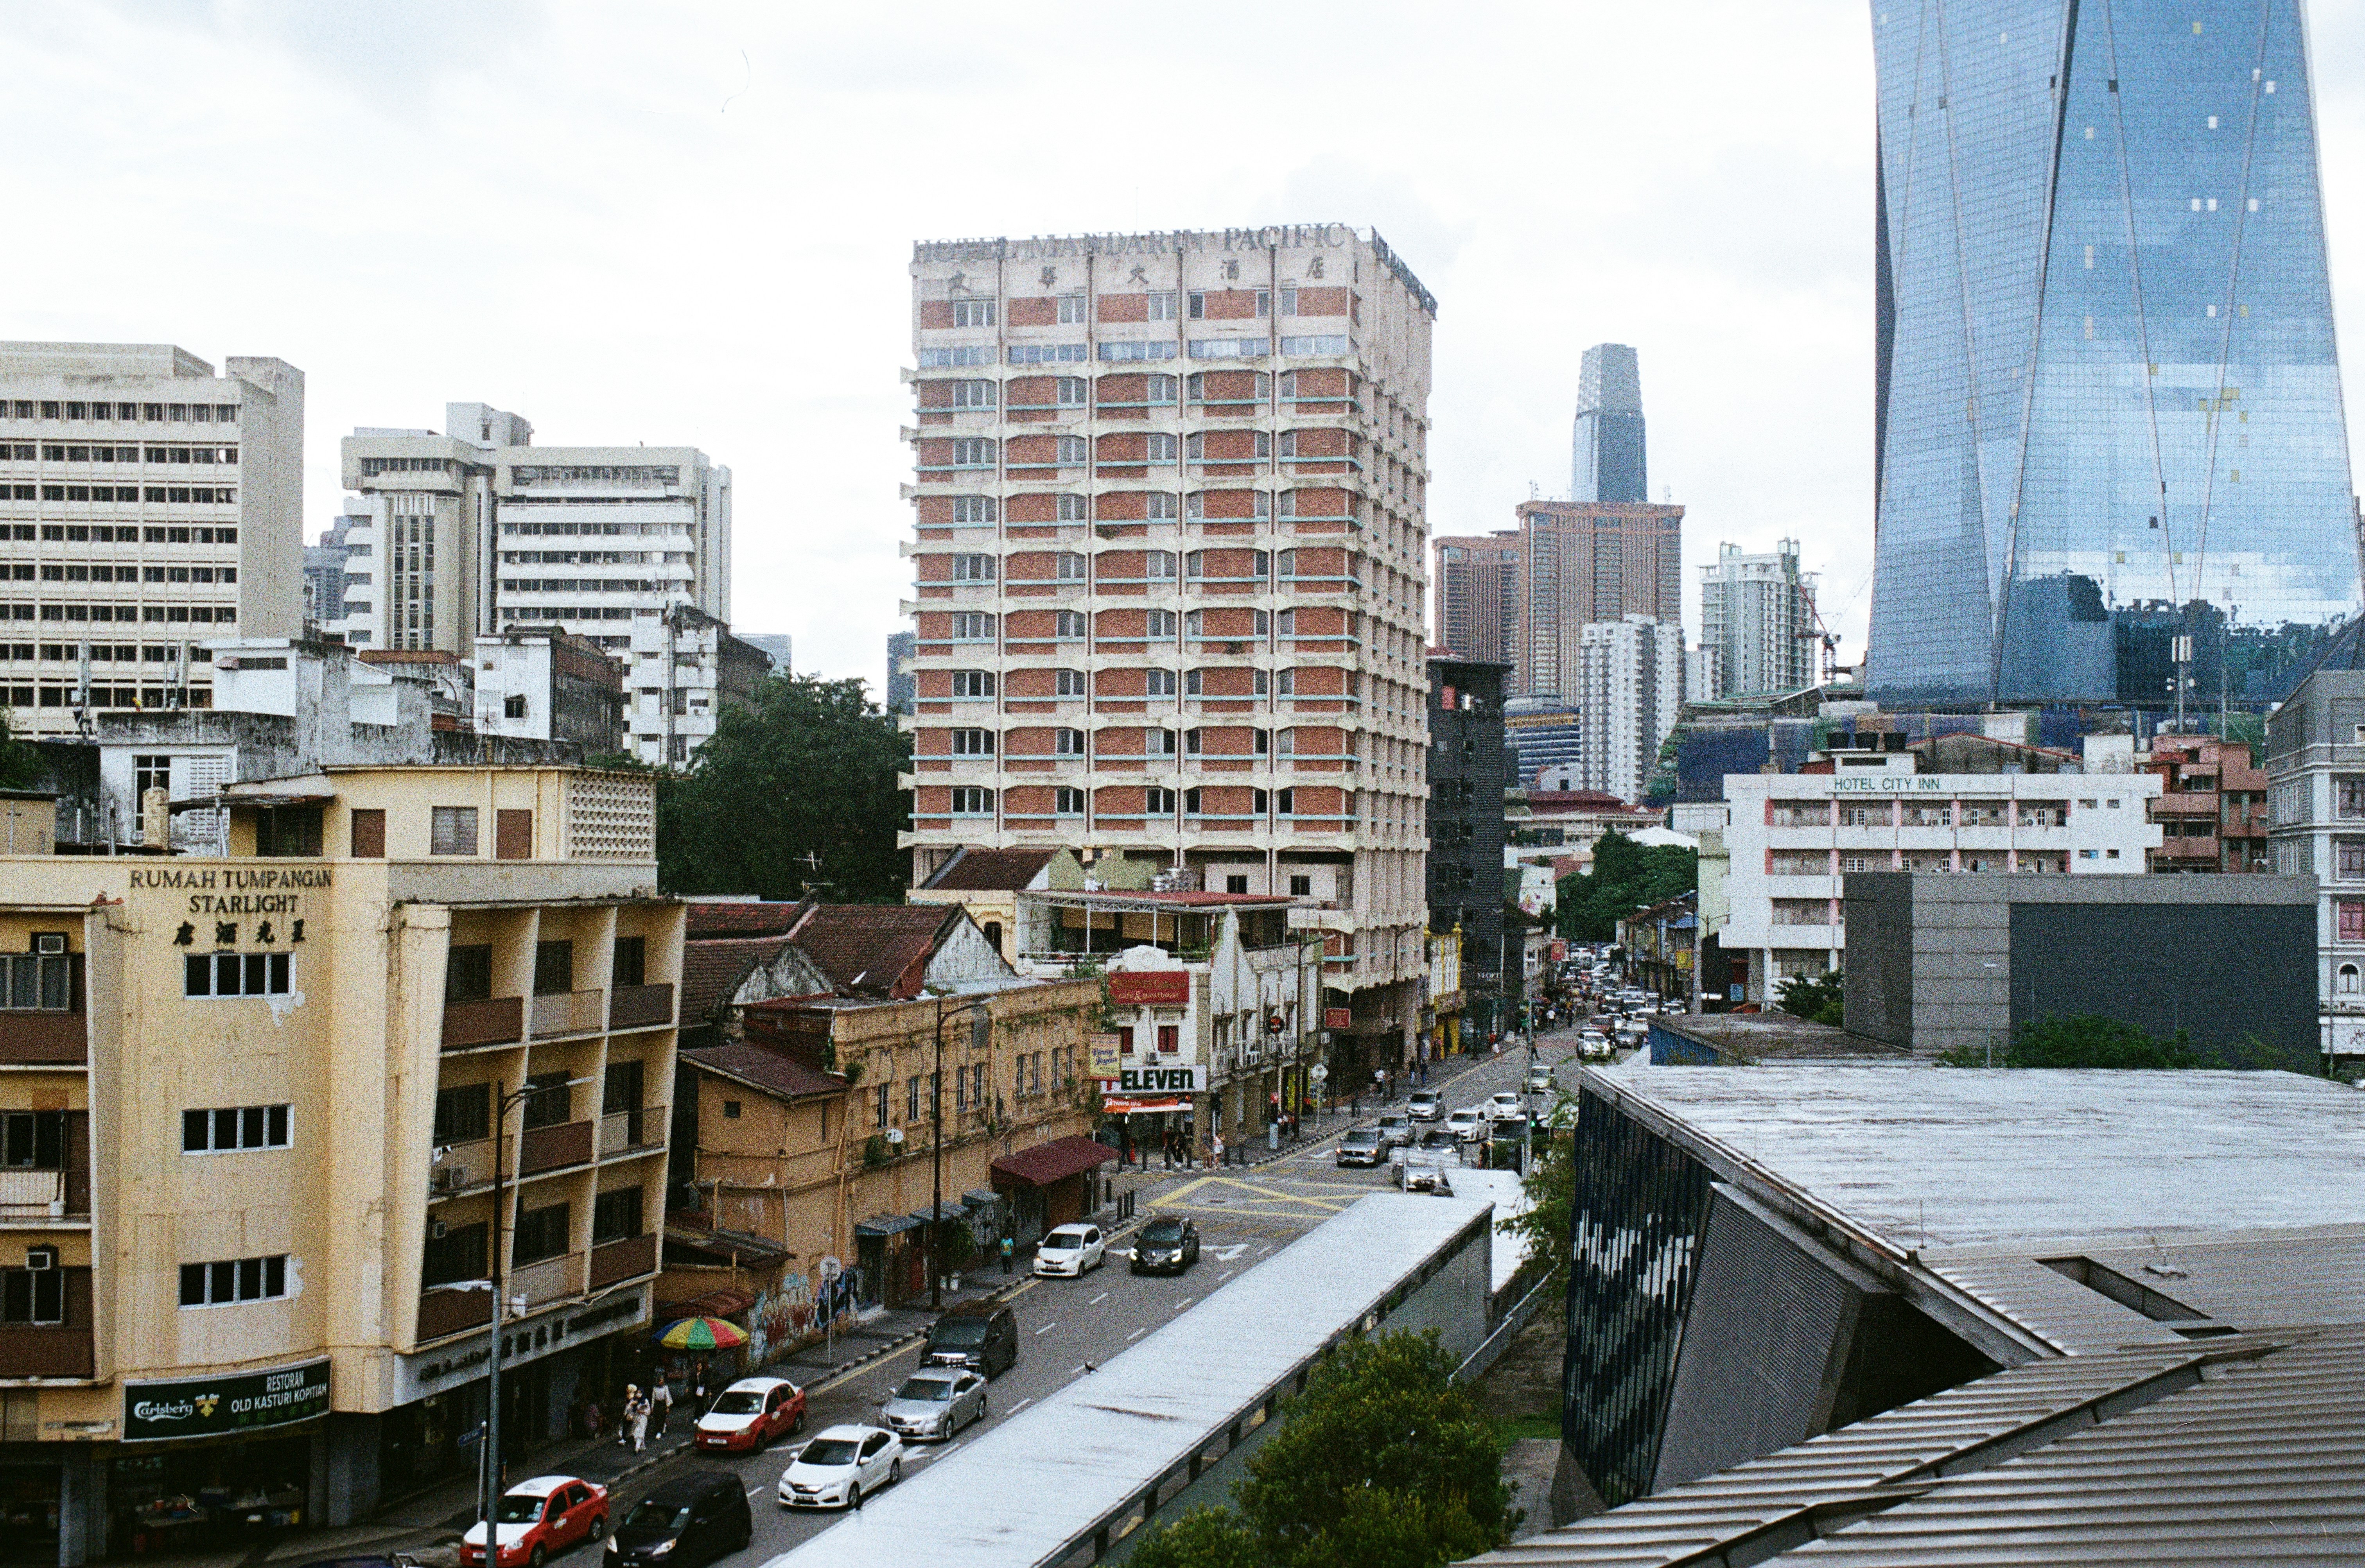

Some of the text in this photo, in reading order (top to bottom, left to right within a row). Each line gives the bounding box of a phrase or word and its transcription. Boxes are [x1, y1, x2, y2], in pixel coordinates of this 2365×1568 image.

[1031, 228, 1204, 258] MANDARIN
[1224, 222, 1345, 251] PACIFIC
[1834, 777, 1940, 790] HOTEL CITY INN
[130, 870, 332, 888] RUMAH TUMPANGAN
[189, 894, 298, 913] STARLIGHT
[266, 1370, 304, 1392] RESTORAN
[231, 1382, 327, 1413] OLD KASTURI KOPITIAM
[134, 1400, 193, 1423] Carlsberg
